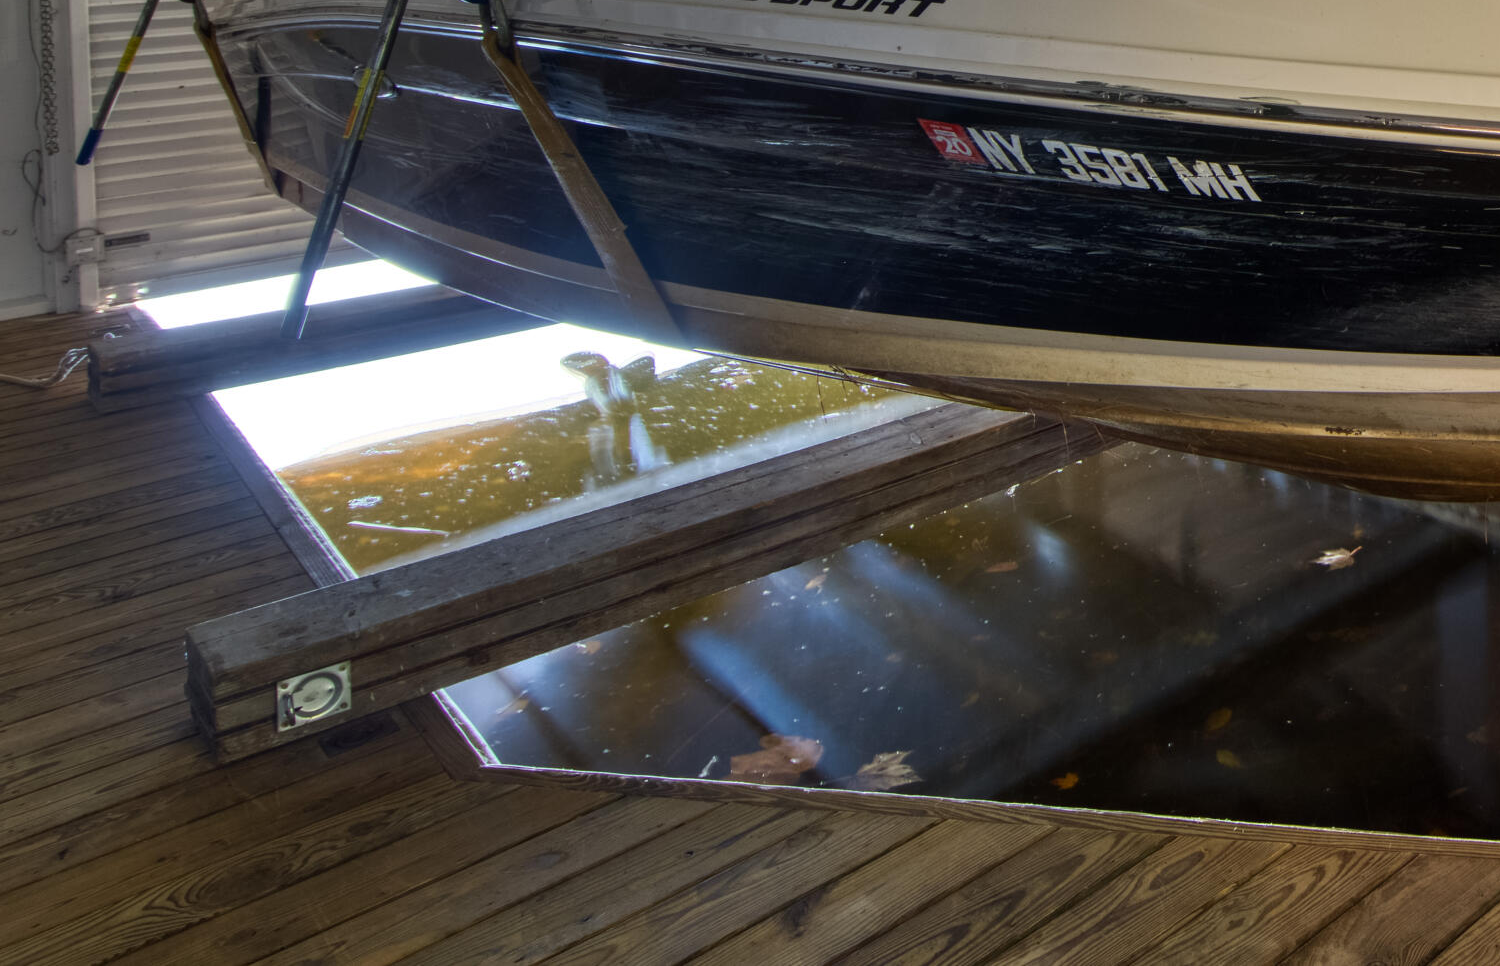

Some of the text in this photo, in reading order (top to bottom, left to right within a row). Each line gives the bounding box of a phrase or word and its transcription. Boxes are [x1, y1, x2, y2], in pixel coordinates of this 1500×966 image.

[935, 135, 973, 157] 20
[966, 126, 1263, 202] NY 3581 MH
